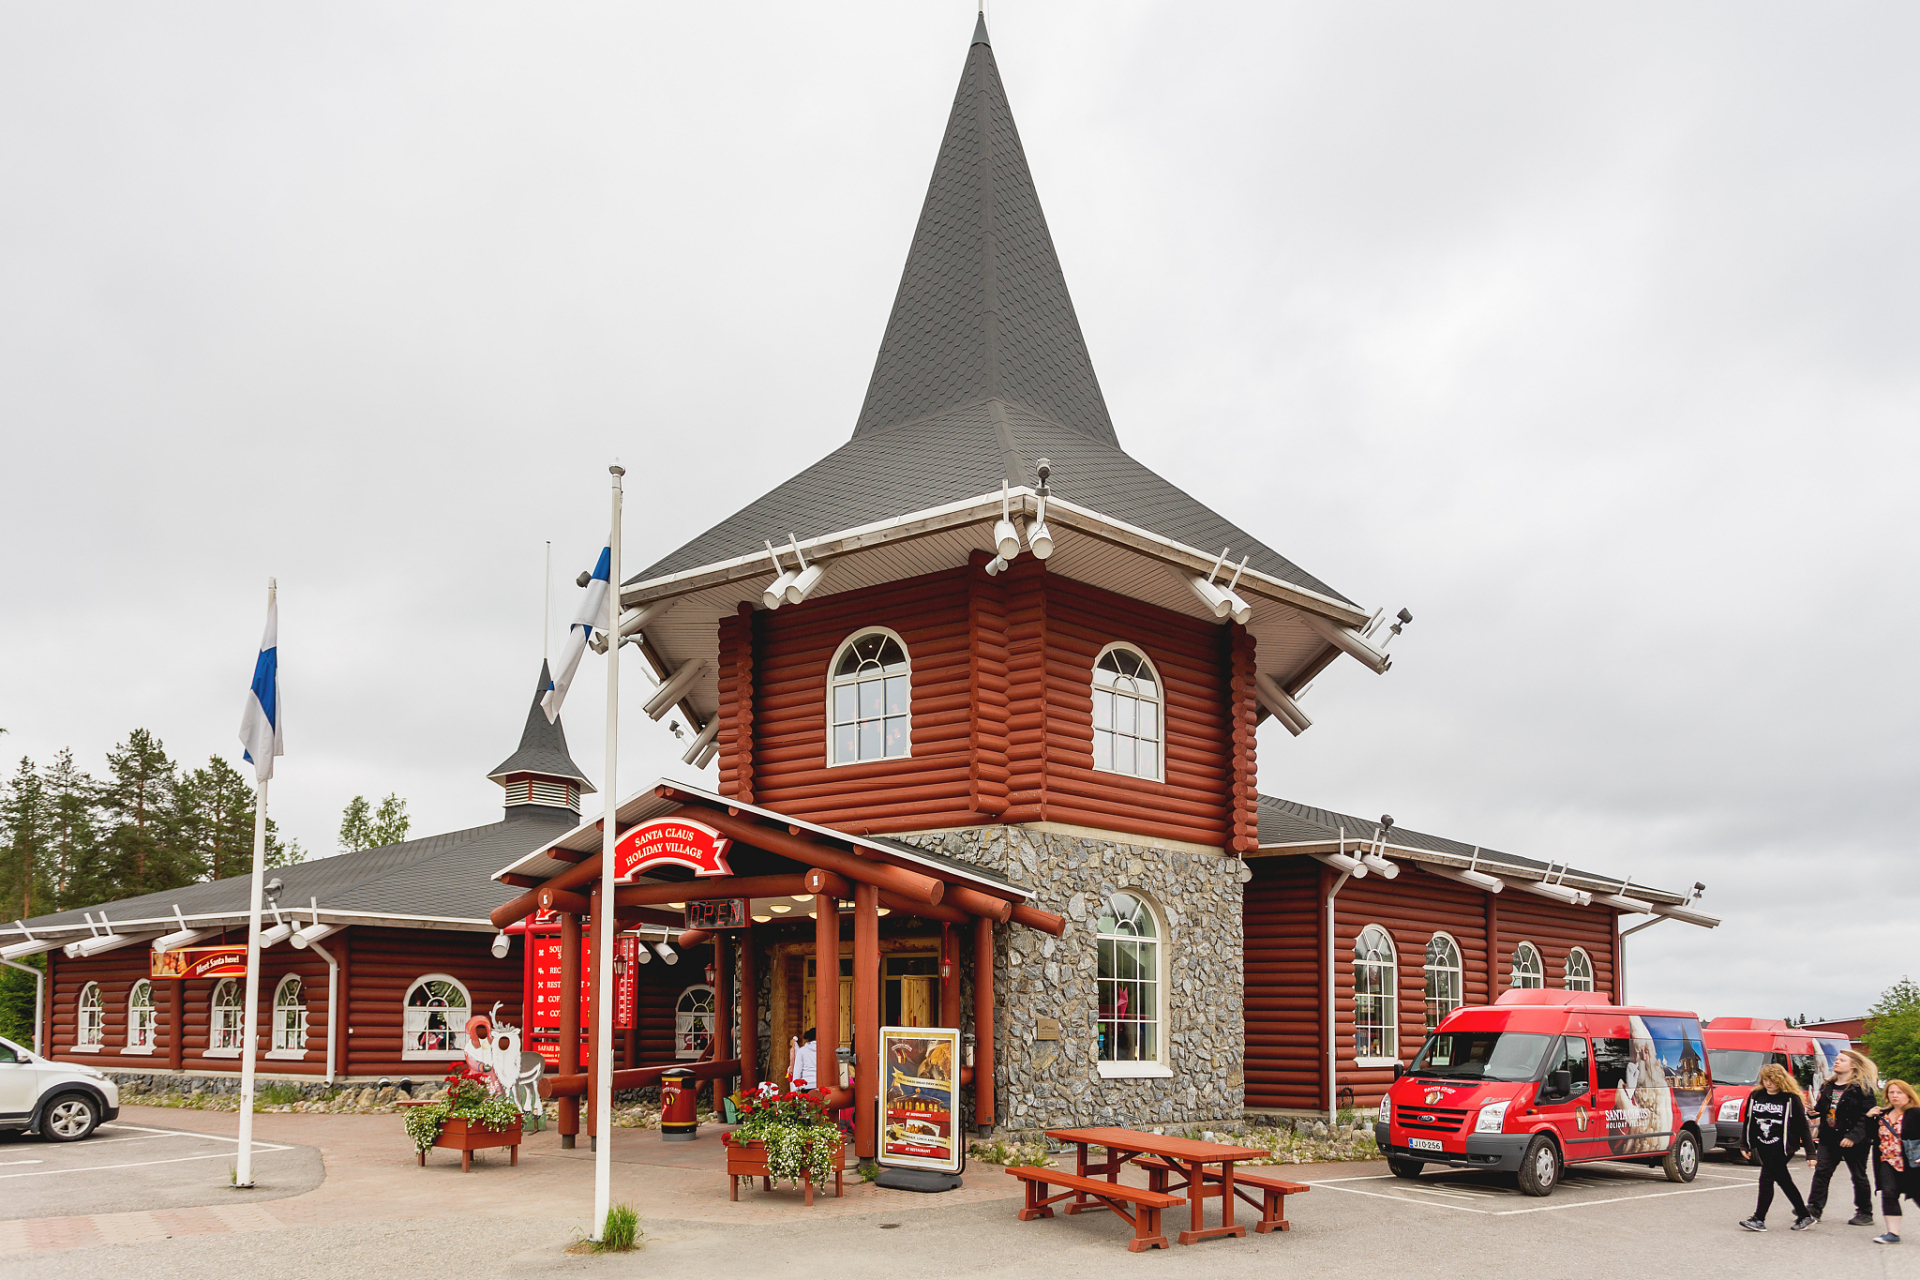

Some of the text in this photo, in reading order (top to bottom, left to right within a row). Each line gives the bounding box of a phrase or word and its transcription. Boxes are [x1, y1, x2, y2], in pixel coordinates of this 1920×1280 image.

[634, 828, 694, 847] SANTA CLAUS
[625, 842, 703, 867] HOLIDAY VILLAGE
[690, 903, 741, 926] OPEN
[196, 955, 239, 975] Meet Santa here!
[1605, 1109, 1627, 1121] SANTA
[1605, 1121, 1627, 1129] HOLIDAY
